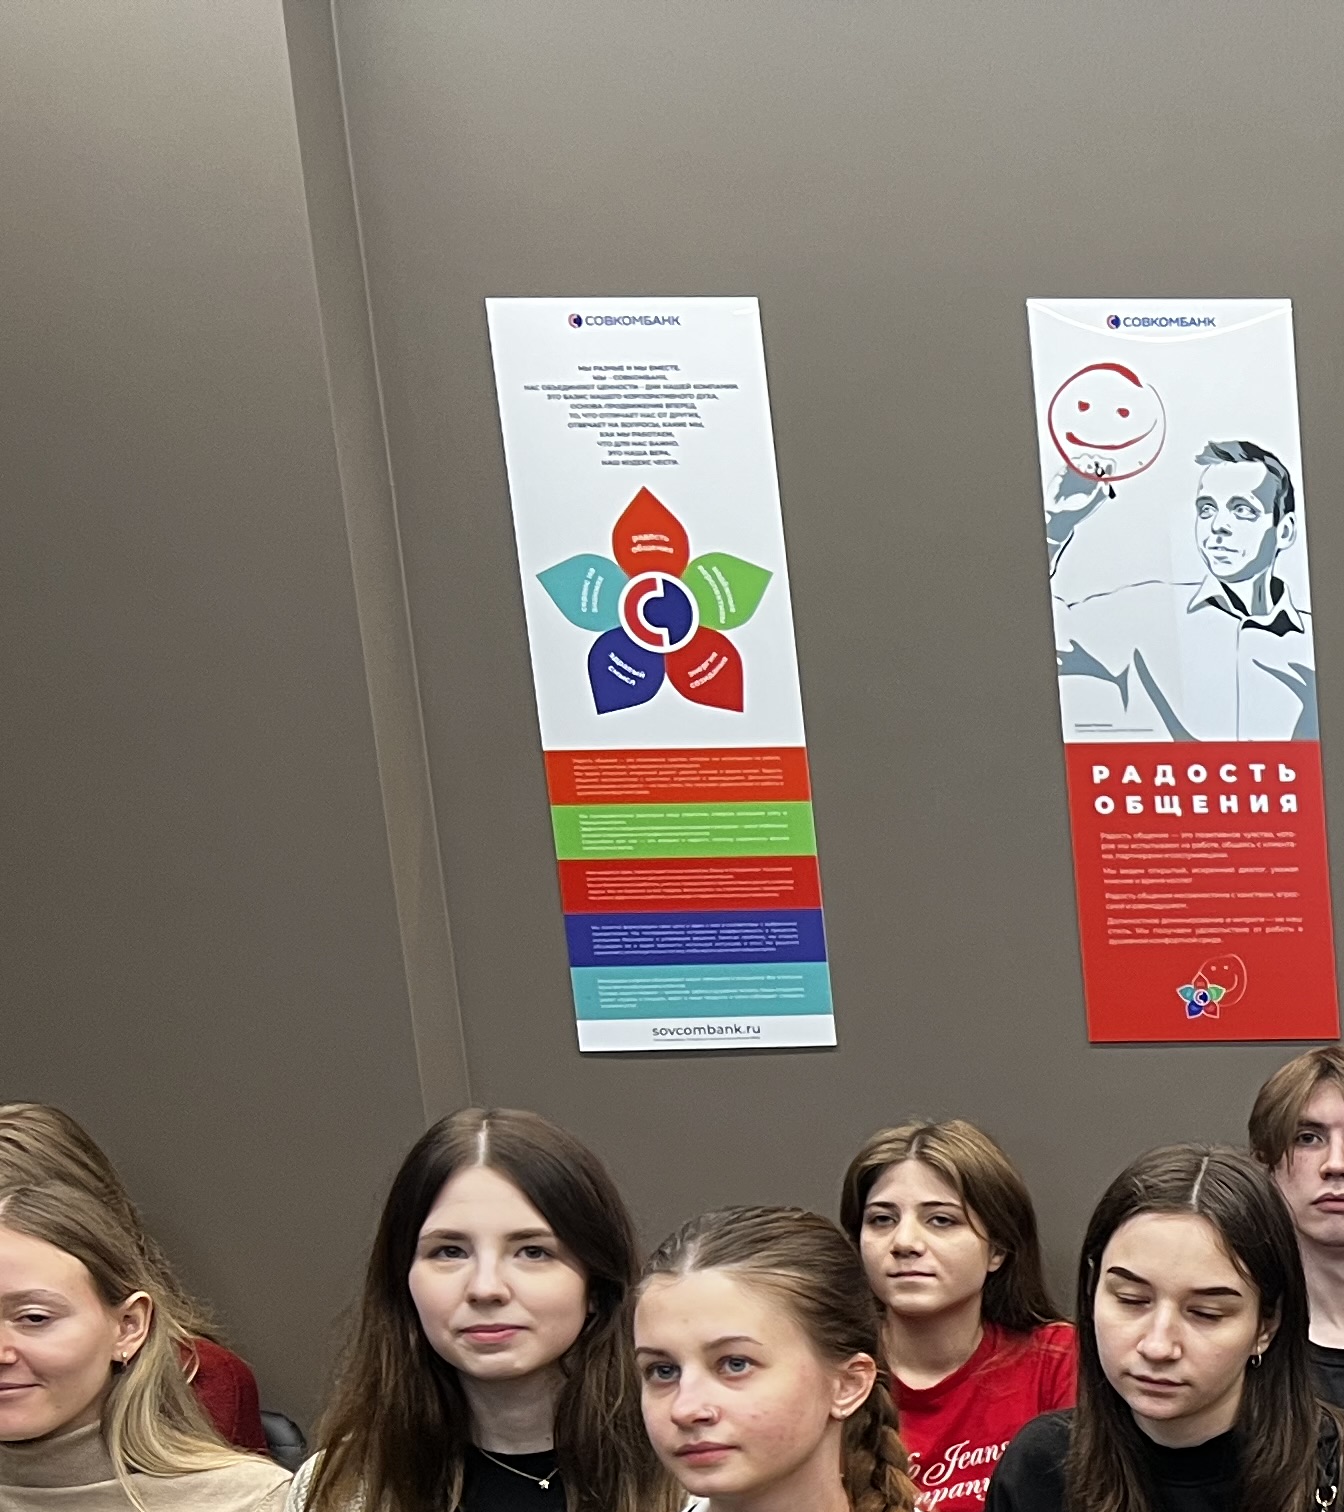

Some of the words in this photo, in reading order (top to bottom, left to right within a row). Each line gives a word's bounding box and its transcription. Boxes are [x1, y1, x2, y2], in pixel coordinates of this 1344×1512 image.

[585, 315, 681, 327] СОВКОМБАНК
[1123, 316, 1216, 328] СОВКОМБАНК
[1091, 764, 1297, 786] РАДОСТЬ
[1094, 794, 1298, 817] ОБЩЕНИЯ
[652, 1024, 761, 1037] sovcombank.ru
